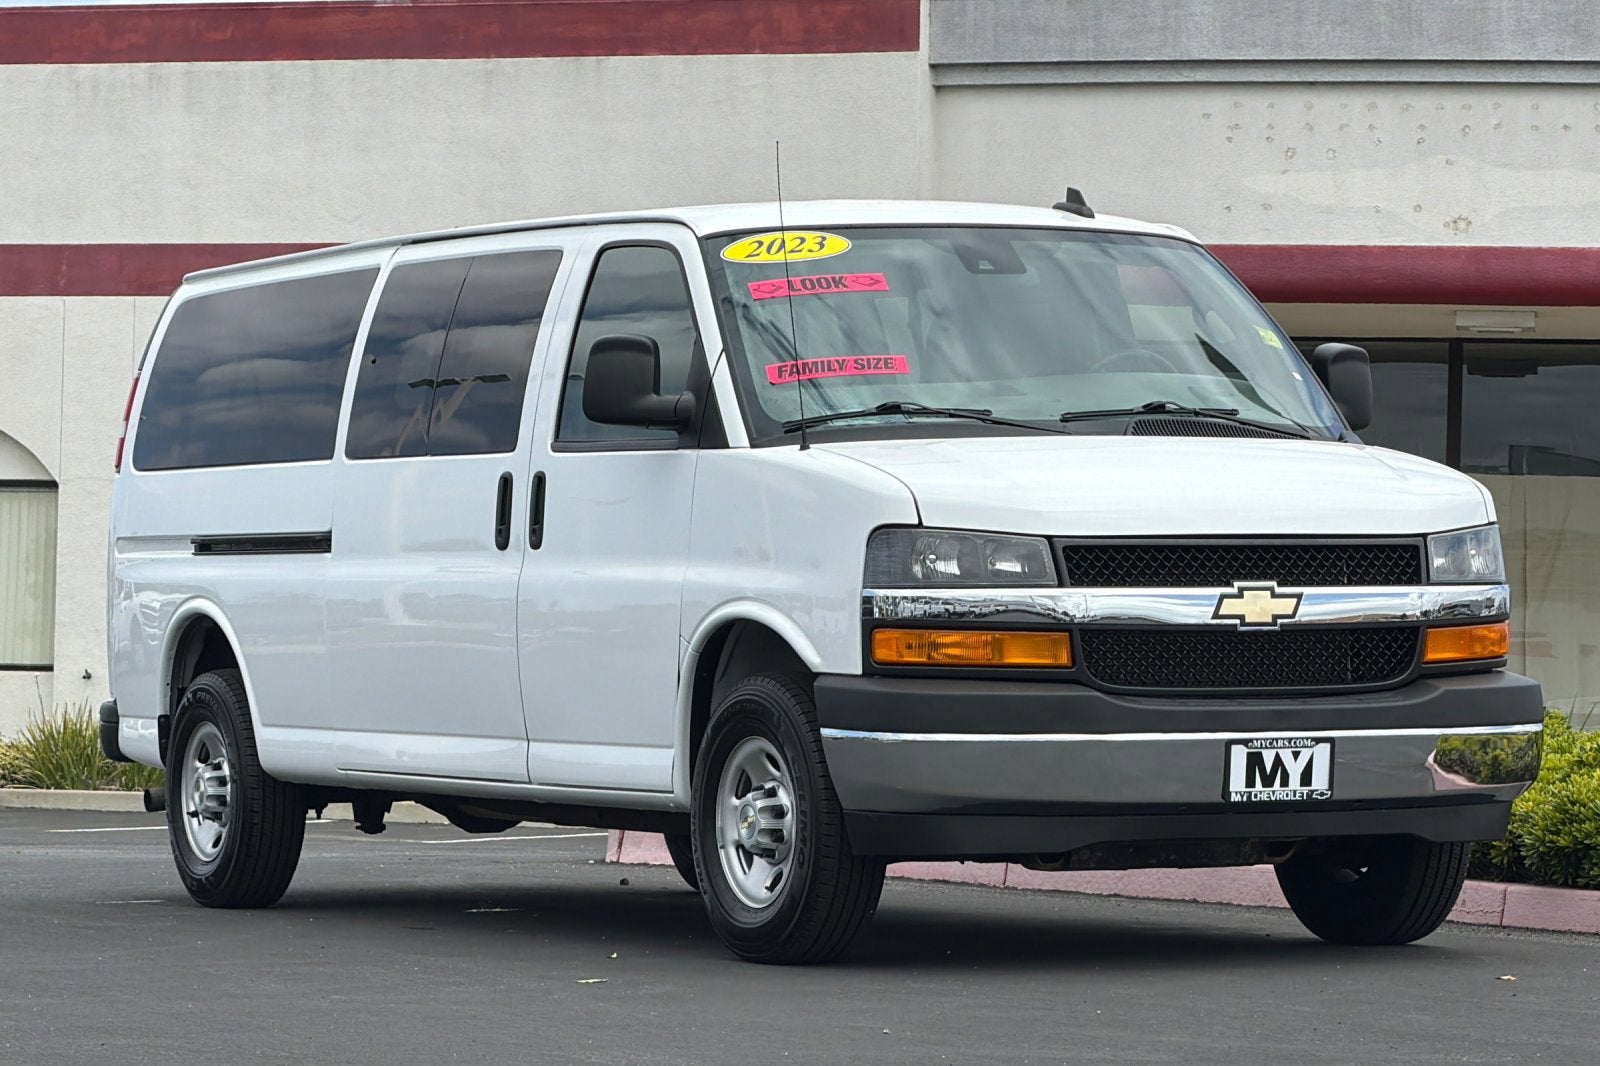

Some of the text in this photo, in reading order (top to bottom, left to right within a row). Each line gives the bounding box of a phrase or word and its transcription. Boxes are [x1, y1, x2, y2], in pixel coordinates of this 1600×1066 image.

[744, 235, 828, 259] 2023
[787, 276, 849, 292] LOOK
[777, 356, 897, 379] FAMILY SIZE
[1244, 750, 1314, 789] MY
[1251, 790, 1308, 801] CHEVROLET
